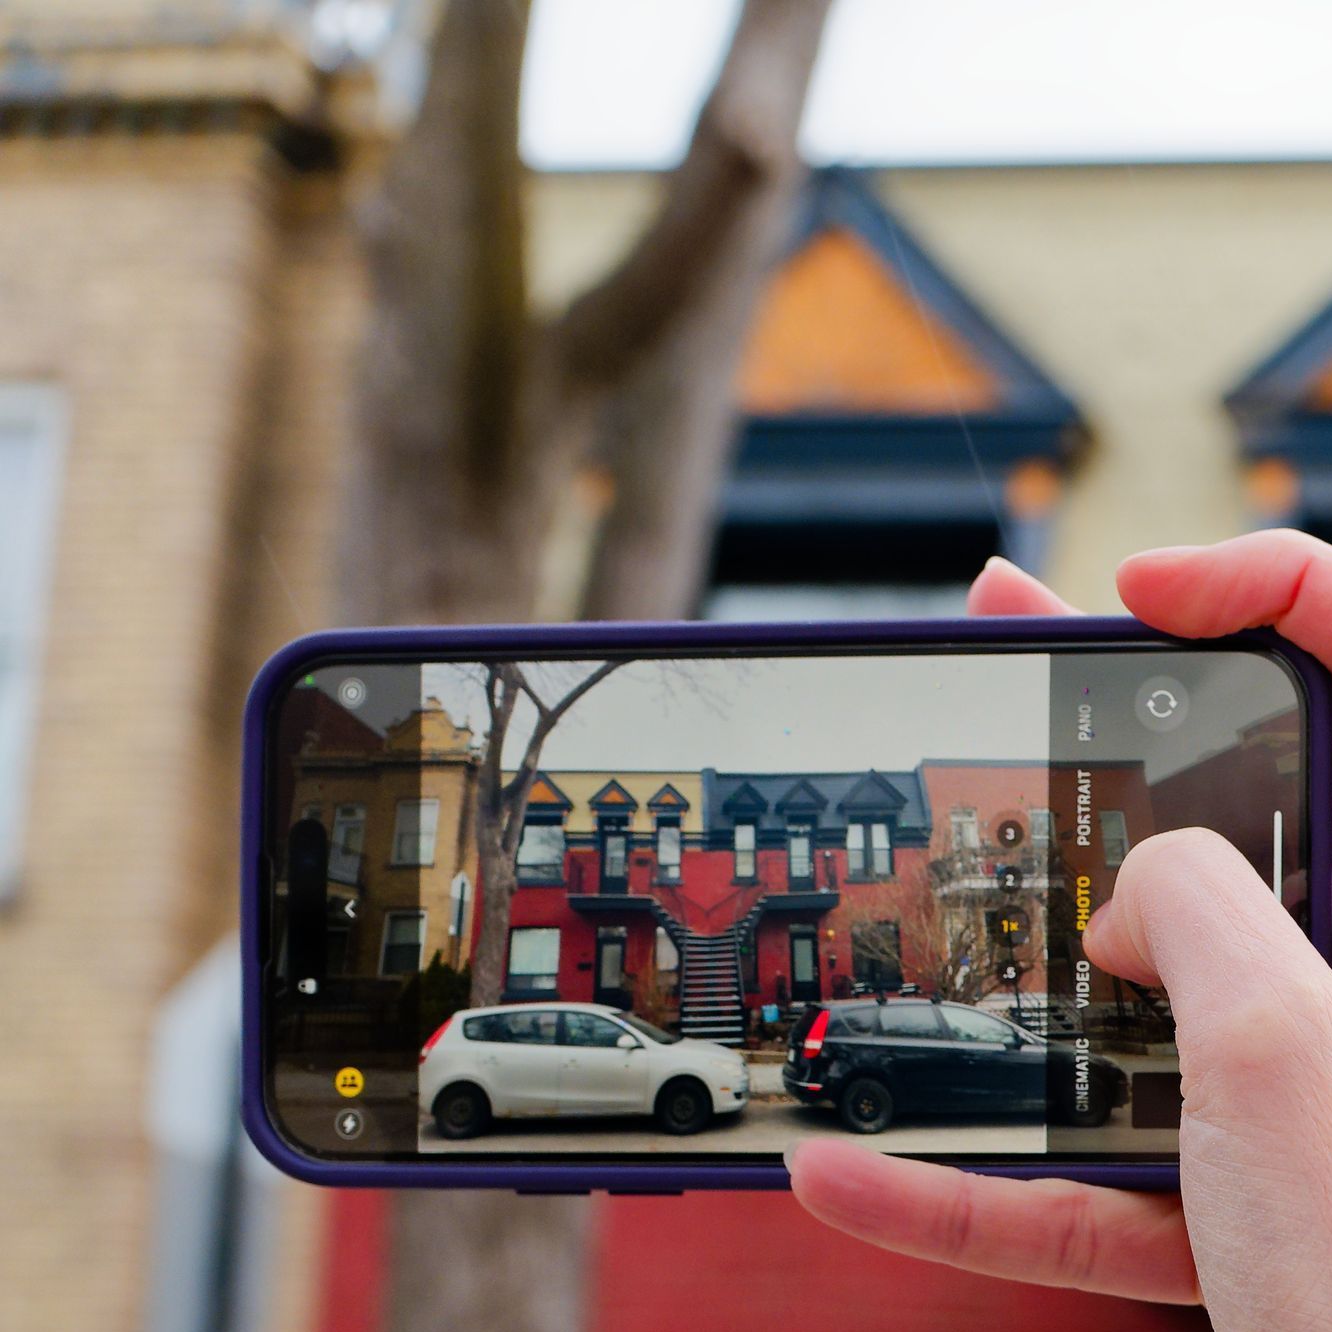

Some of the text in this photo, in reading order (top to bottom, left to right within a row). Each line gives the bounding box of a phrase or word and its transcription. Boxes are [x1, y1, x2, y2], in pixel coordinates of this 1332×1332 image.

[1005, 827, 1016, 841] 3
[1005, 874, 1016, 887] 2
[1075, 704, 1092, 1112] CINEMATIC VIDEO PHOTO PORTRAIT PANO
